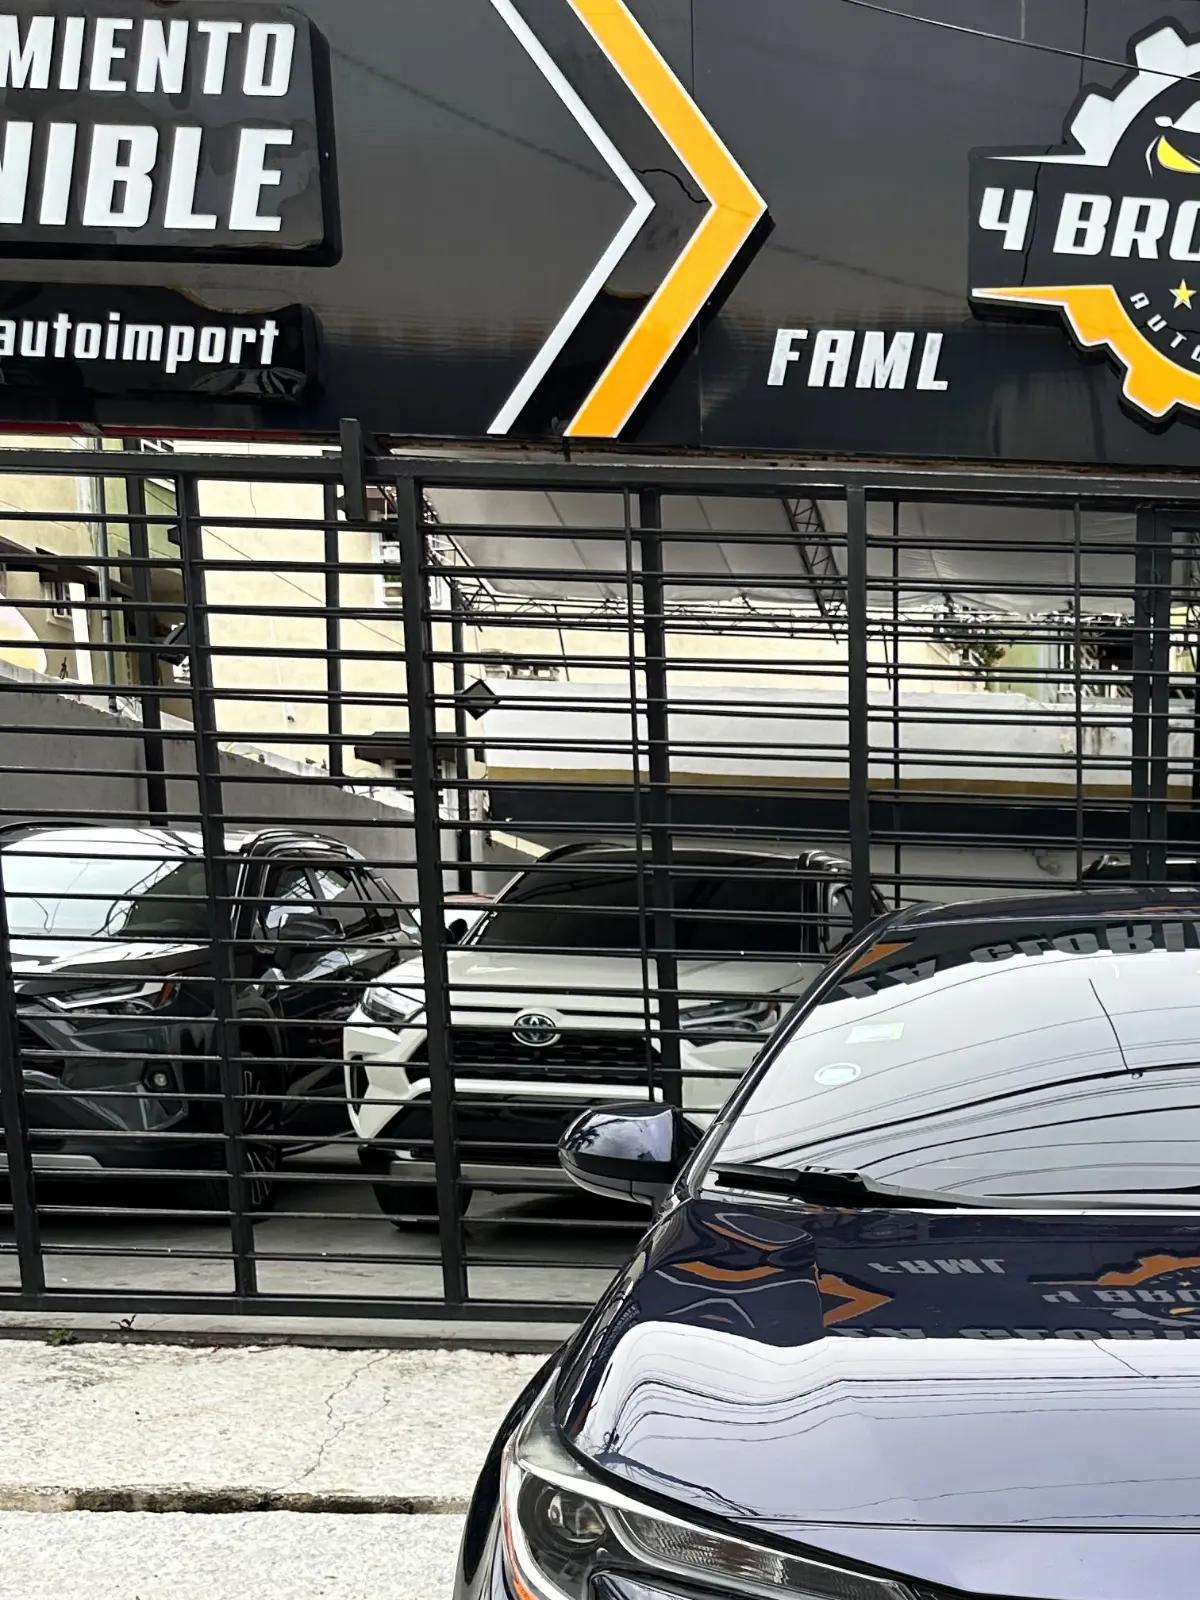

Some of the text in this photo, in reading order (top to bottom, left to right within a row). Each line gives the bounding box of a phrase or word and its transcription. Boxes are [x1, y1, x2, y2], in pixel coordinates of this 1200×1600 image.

[0, 14, 295, 97] MIENTO
[978, 187, 1034, 251] 4
[766, 328, 949, 391] FAML
